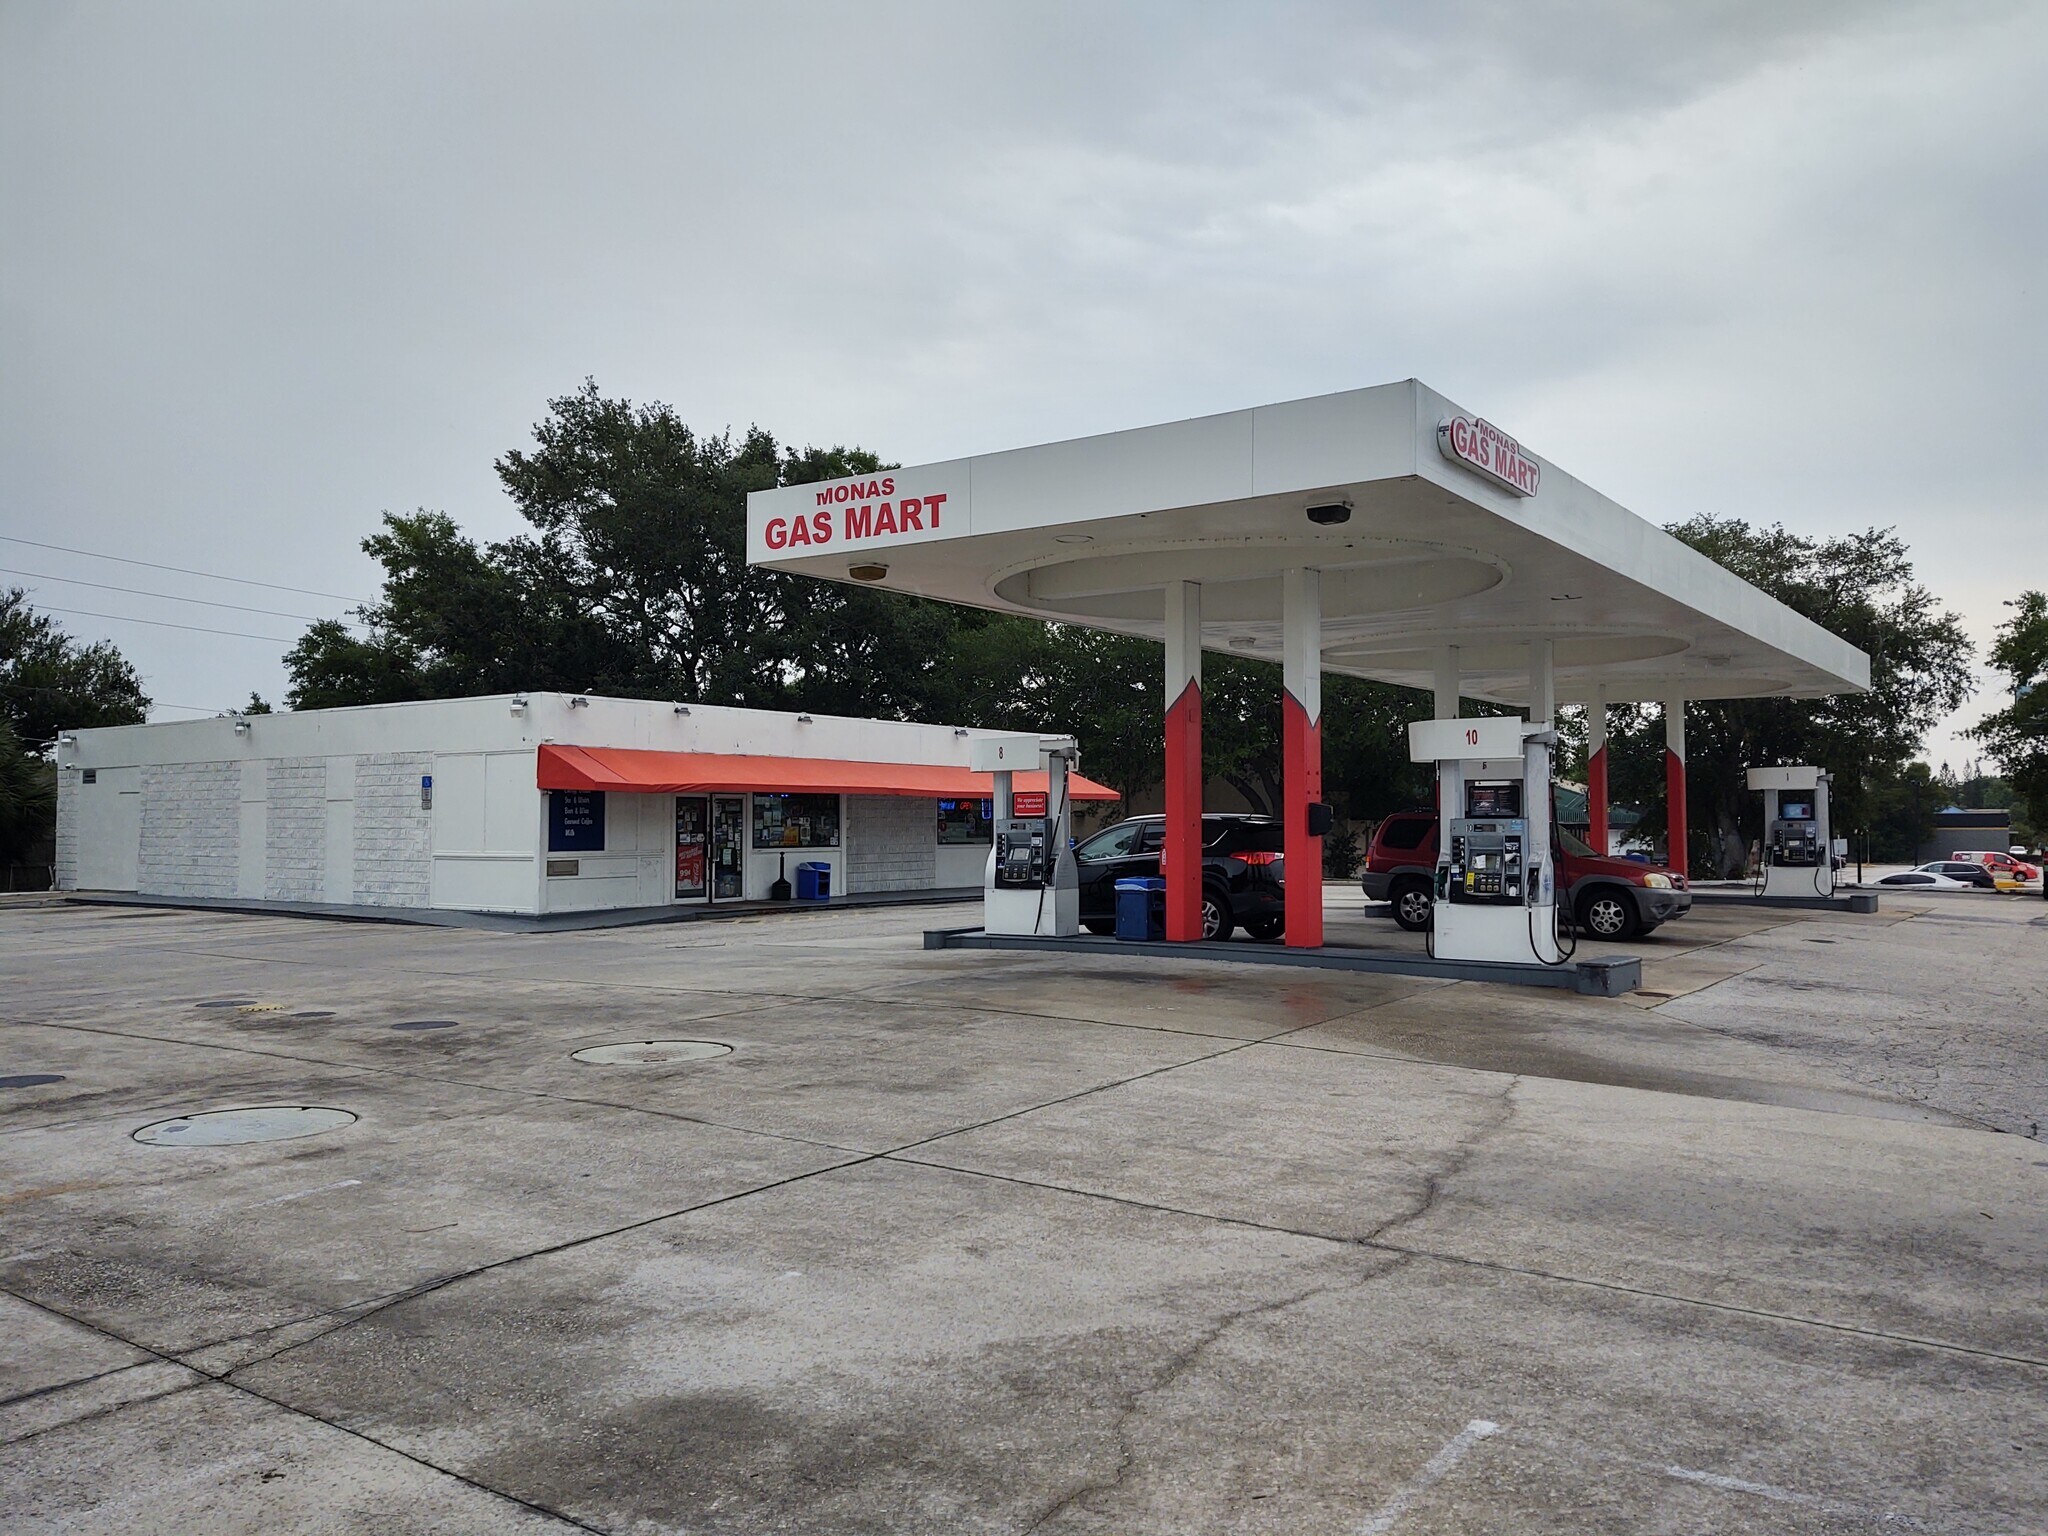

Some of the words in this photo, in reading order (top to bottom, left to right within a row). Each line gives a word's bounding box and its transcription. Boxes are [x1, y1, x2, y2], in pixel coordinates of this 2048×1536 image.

[1480, 423, 1516, 454] MONAS
[1455, 422, 1489, 466] GAS
[1495, 445, 1537, 493] MART
[816, 477, 895, 506] MONAS
[765, 511, 833, 550] GAS
[845, 493, 947, 540] MART
[1466, 729, 1478, 745] 10
[998, 746, 1004, 760] 8
[1023, 796, 1044, 804] appreciate
